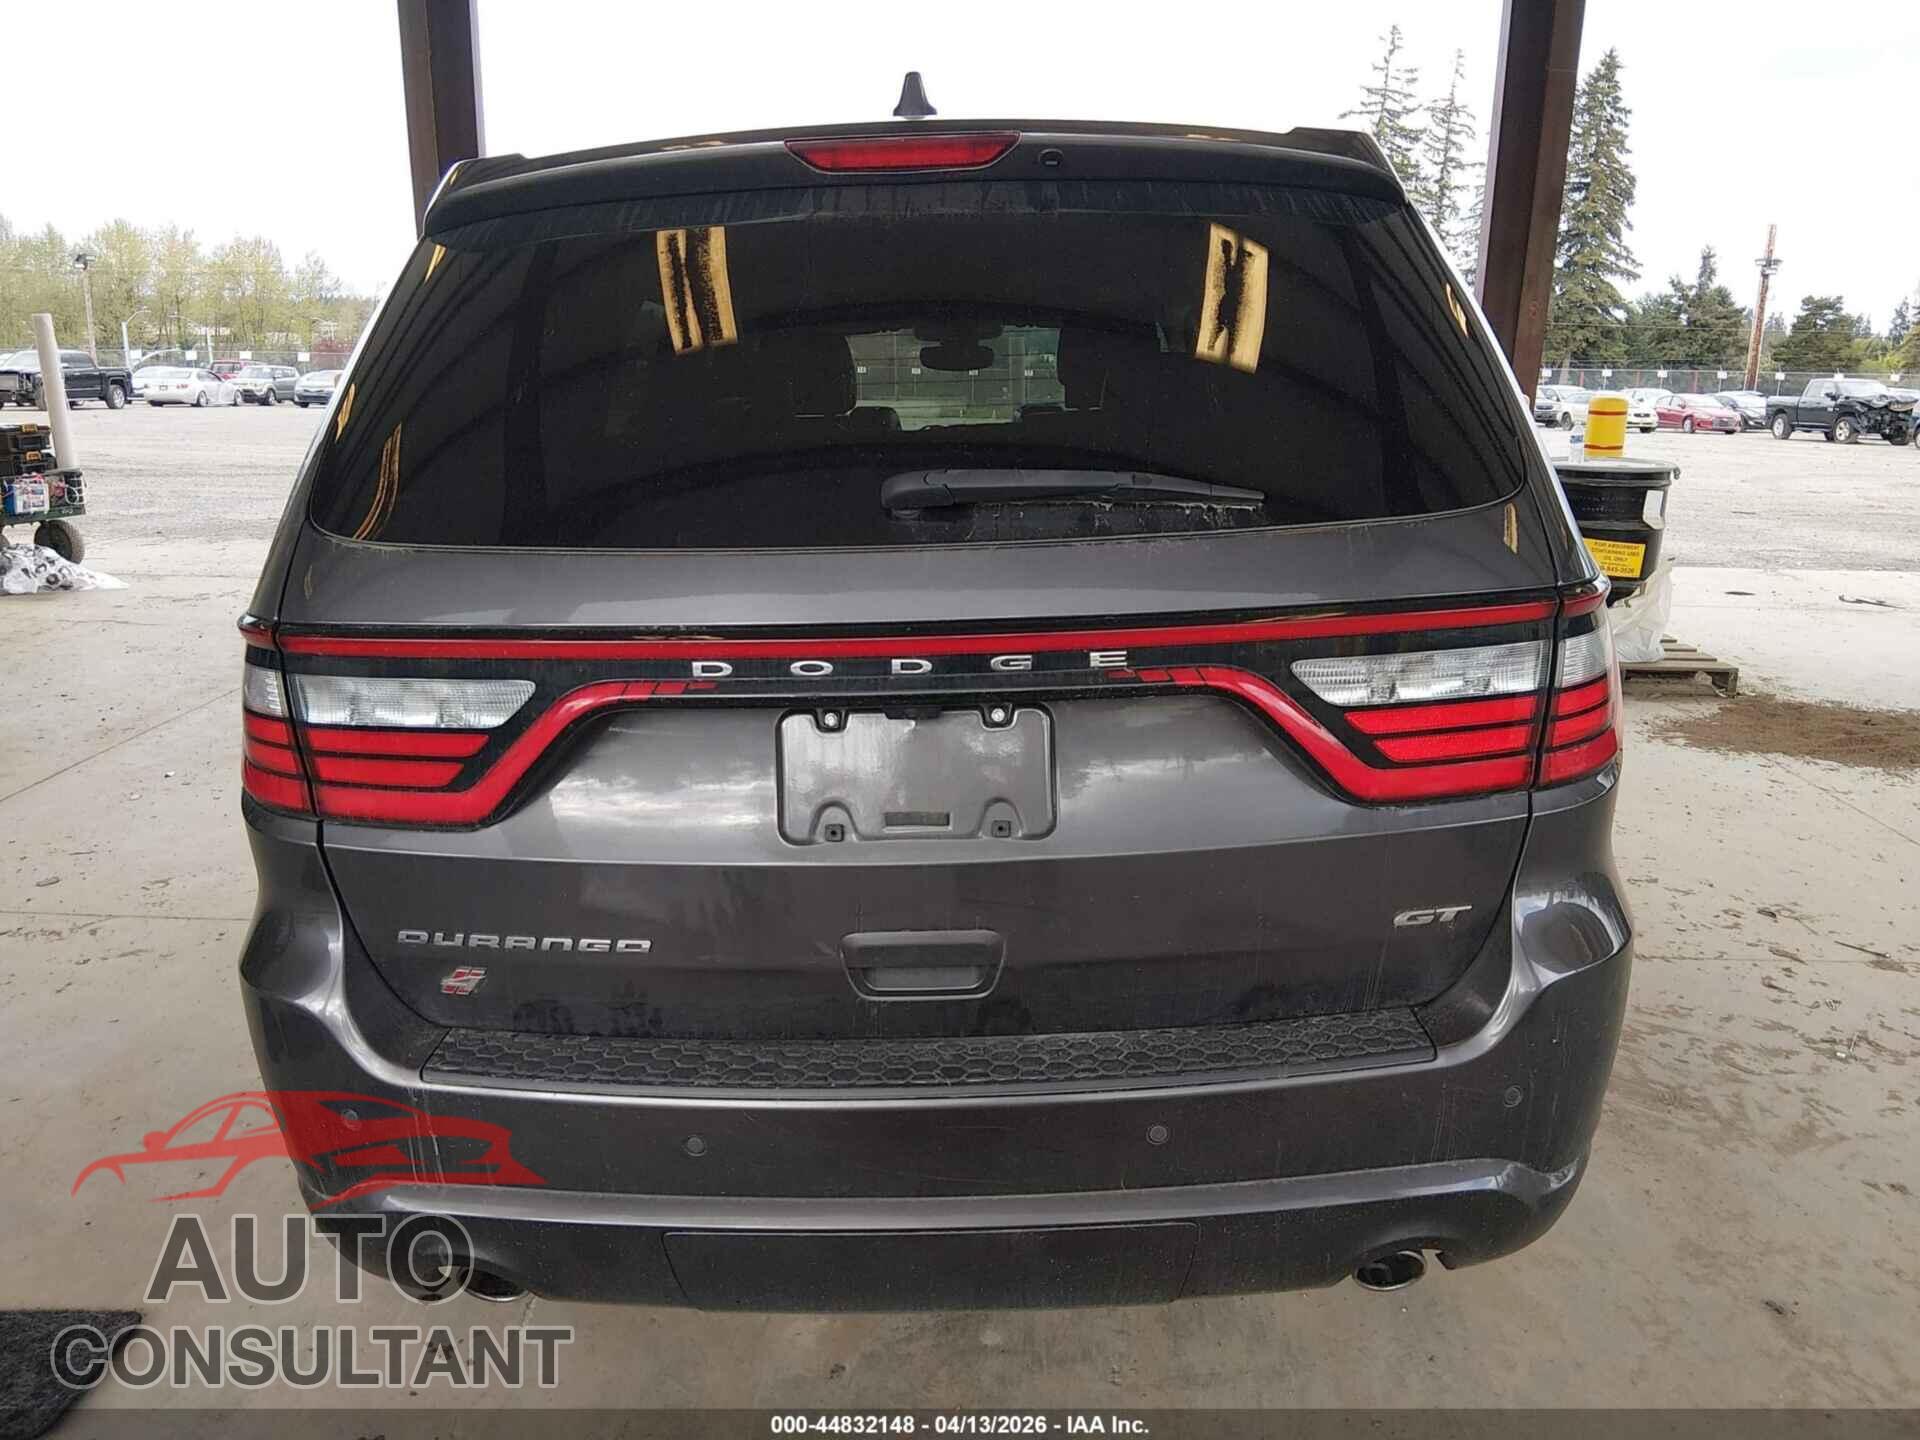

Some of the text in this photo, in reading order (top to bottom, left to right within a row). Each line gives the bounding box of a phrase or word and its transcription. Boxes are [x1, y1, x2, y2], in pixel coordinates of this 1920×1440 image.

[691, 650, 1128, 678] DODGE
[1393, 905, 1472, 926] GT
[397, 930, 652, 953] DURANGO
